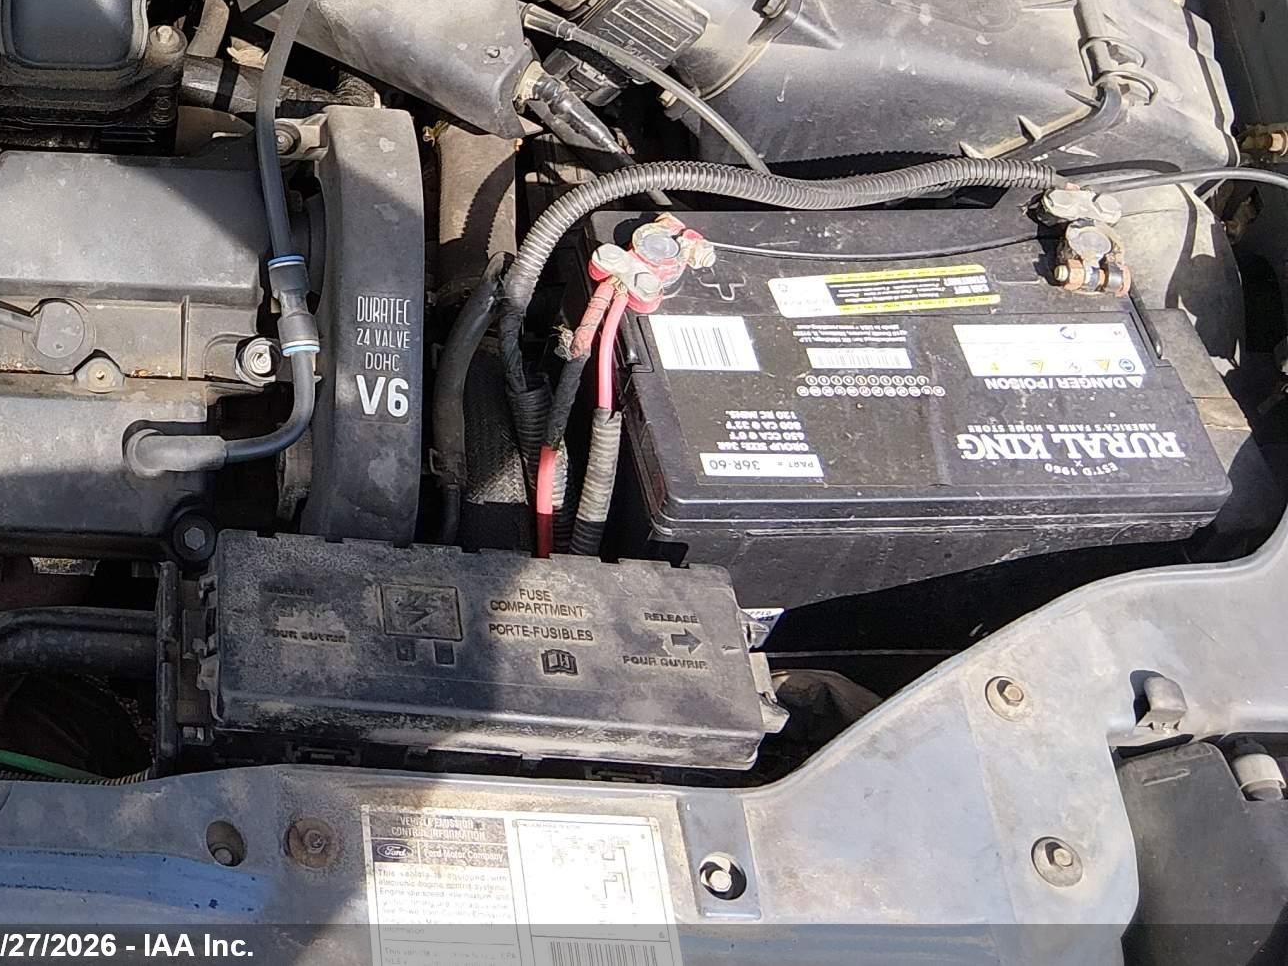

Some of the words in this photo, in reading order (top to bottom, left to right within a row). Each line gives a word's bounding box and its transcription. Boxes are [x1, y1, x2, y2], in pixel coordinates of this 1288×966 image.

[356, 296, 411, 326] DURATEC
[356, 328, 370, 346] 24
[375, 330, 410, 348] VALVE
[365, 352, 400, 372] DOHC
[356, 374, 408, 417] V6
[967, 424, 1005, 433] STORE
[1008, 424, 1043, 433] HOME
[1046, 424, 1055, 432] &
[1058, 424, 1091, 433] FARM
[1095, 423, 1156, 433] AMERICA'S
[769, 441, 809, 451] GROUP
[956, 433, 1051, 460] KING
[1051, 431, 1185, 460] RURAL
[709, 459, 760, 470] 36R-60
[1044, 463, 1077, 476] 1960
[1082, 461, 1119, 476] EST'D
[518, 588, 552, 602] FUSE
[490, 600, 585, 618] COMPARTMENT
[644, 611, 699, 624] RELEASE
[488, 623, 594, 642] PORTE-FUSIBLES
[623, 655, 657, 666] POUR
[430, 828, 487, 842] INFORMATION
[443, 849, 467, 861] Motor
[468, 850, 504, 863] Company
